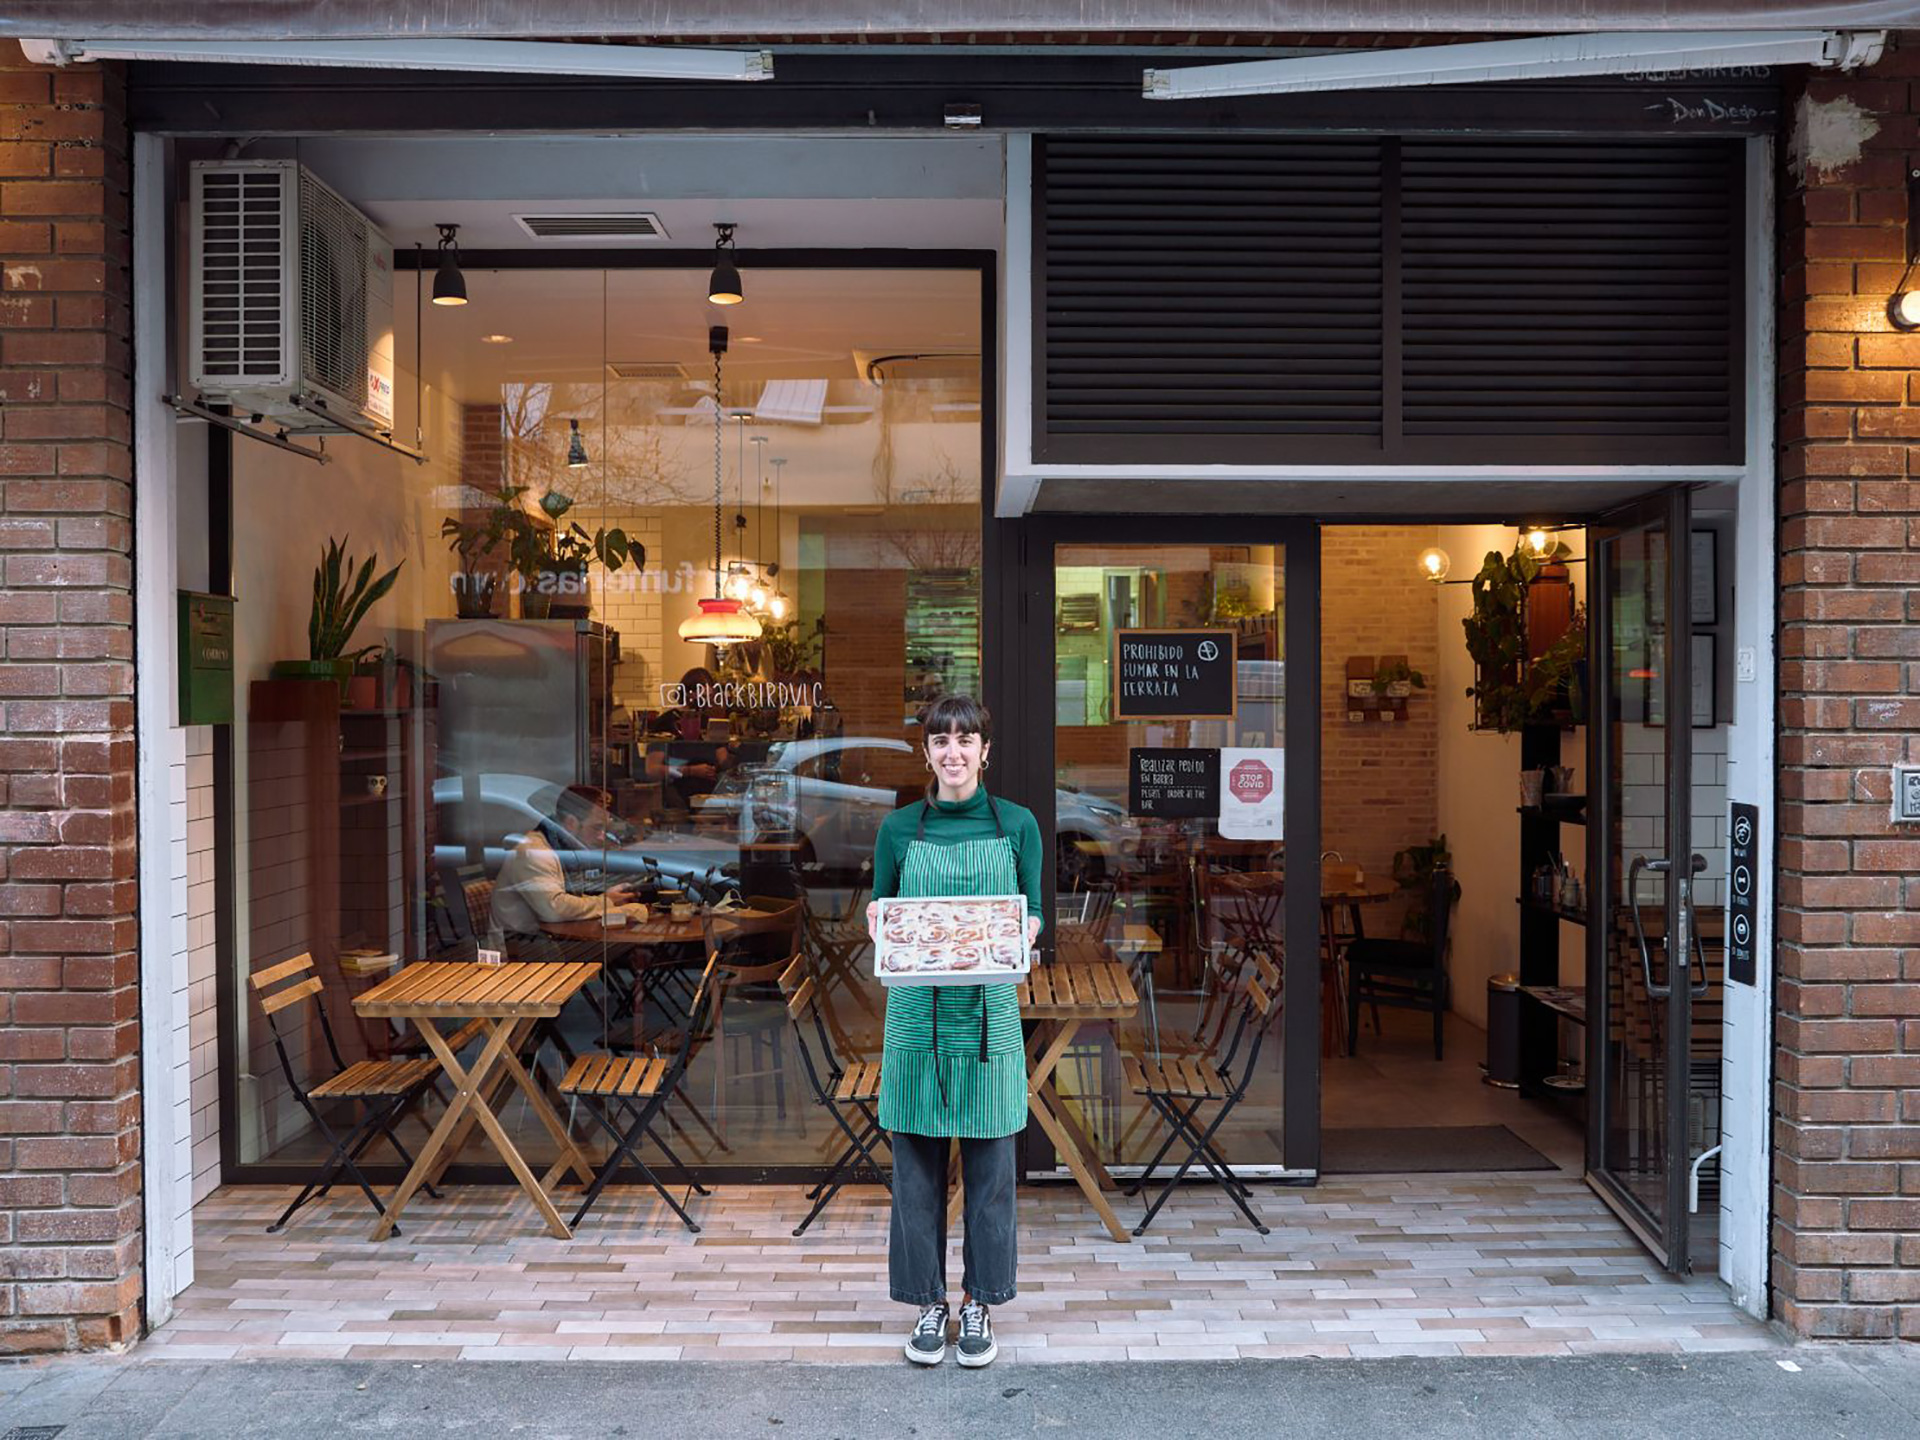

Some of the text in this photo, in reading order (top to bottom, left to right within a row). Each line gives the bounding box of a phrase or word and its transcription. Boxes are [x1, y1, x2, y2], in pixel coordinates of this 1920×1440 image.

[1123, 643, 1183, 661] PROHIBIDO
[1123, 662, 1199, 680] FUMAR EN LA
[1123, 681, 1179, 696] TERRAZA
[1238, 780, 1265, 789] COVID
[1240, 773, 1263, 782] STOP
